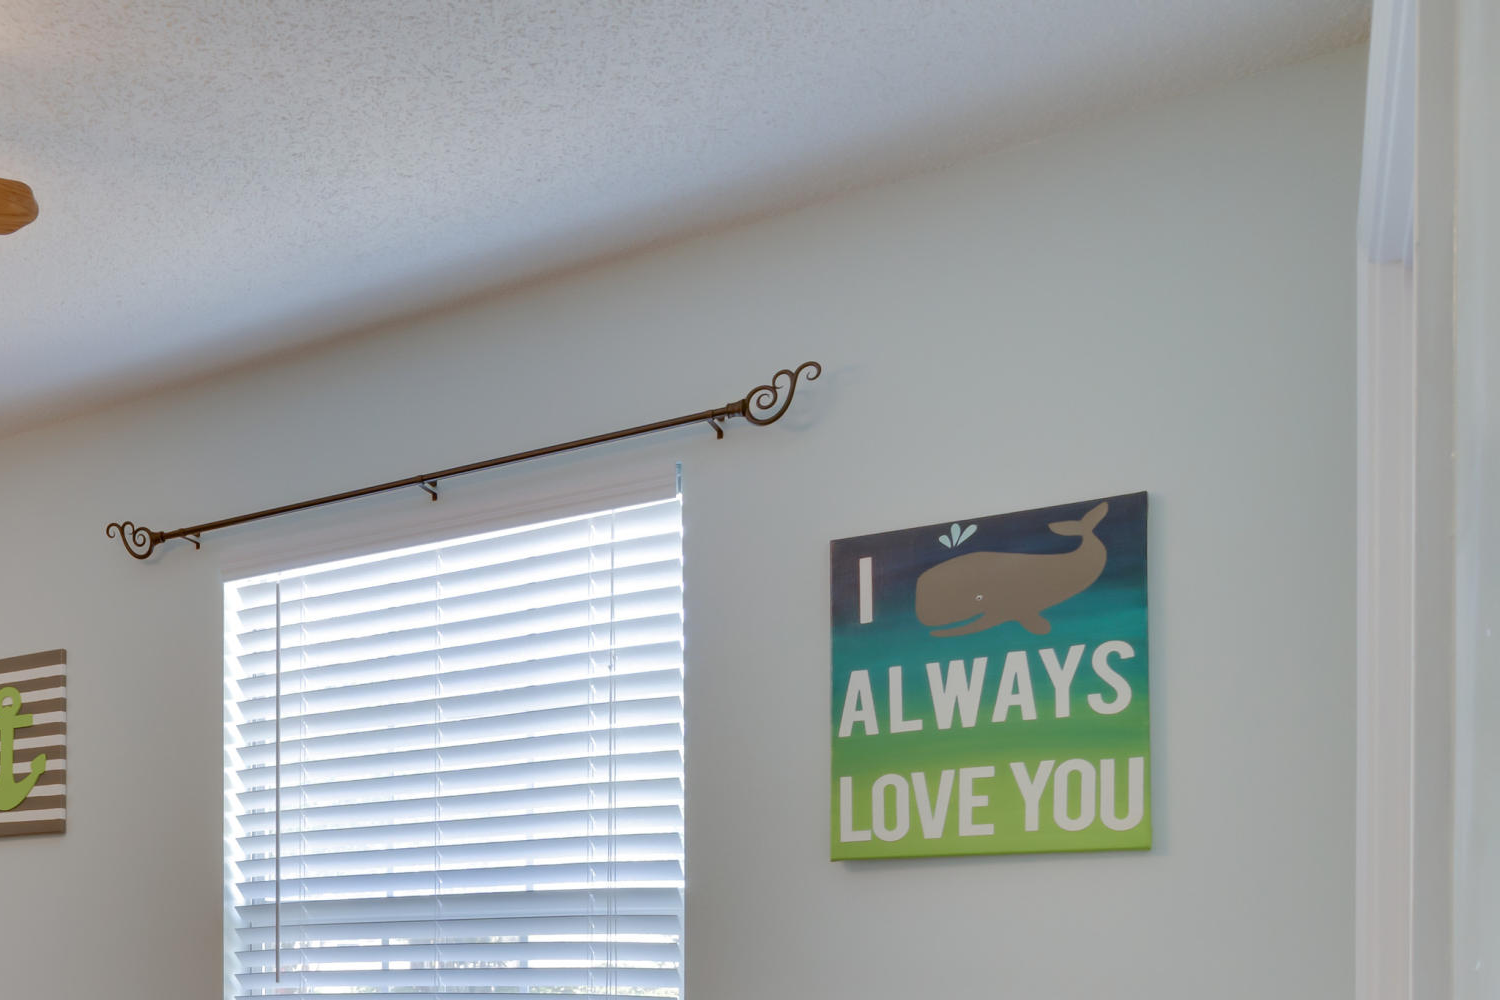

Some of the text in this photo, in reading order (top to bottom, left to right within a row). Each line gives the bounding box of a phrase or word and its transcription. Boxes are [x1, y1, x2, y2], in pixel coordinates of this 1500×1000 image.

[858, 556, 874, 625] I
[838, 640, 1136, 738] ALWAYS
[839, 756, 1145, 843] LOVE YOU
